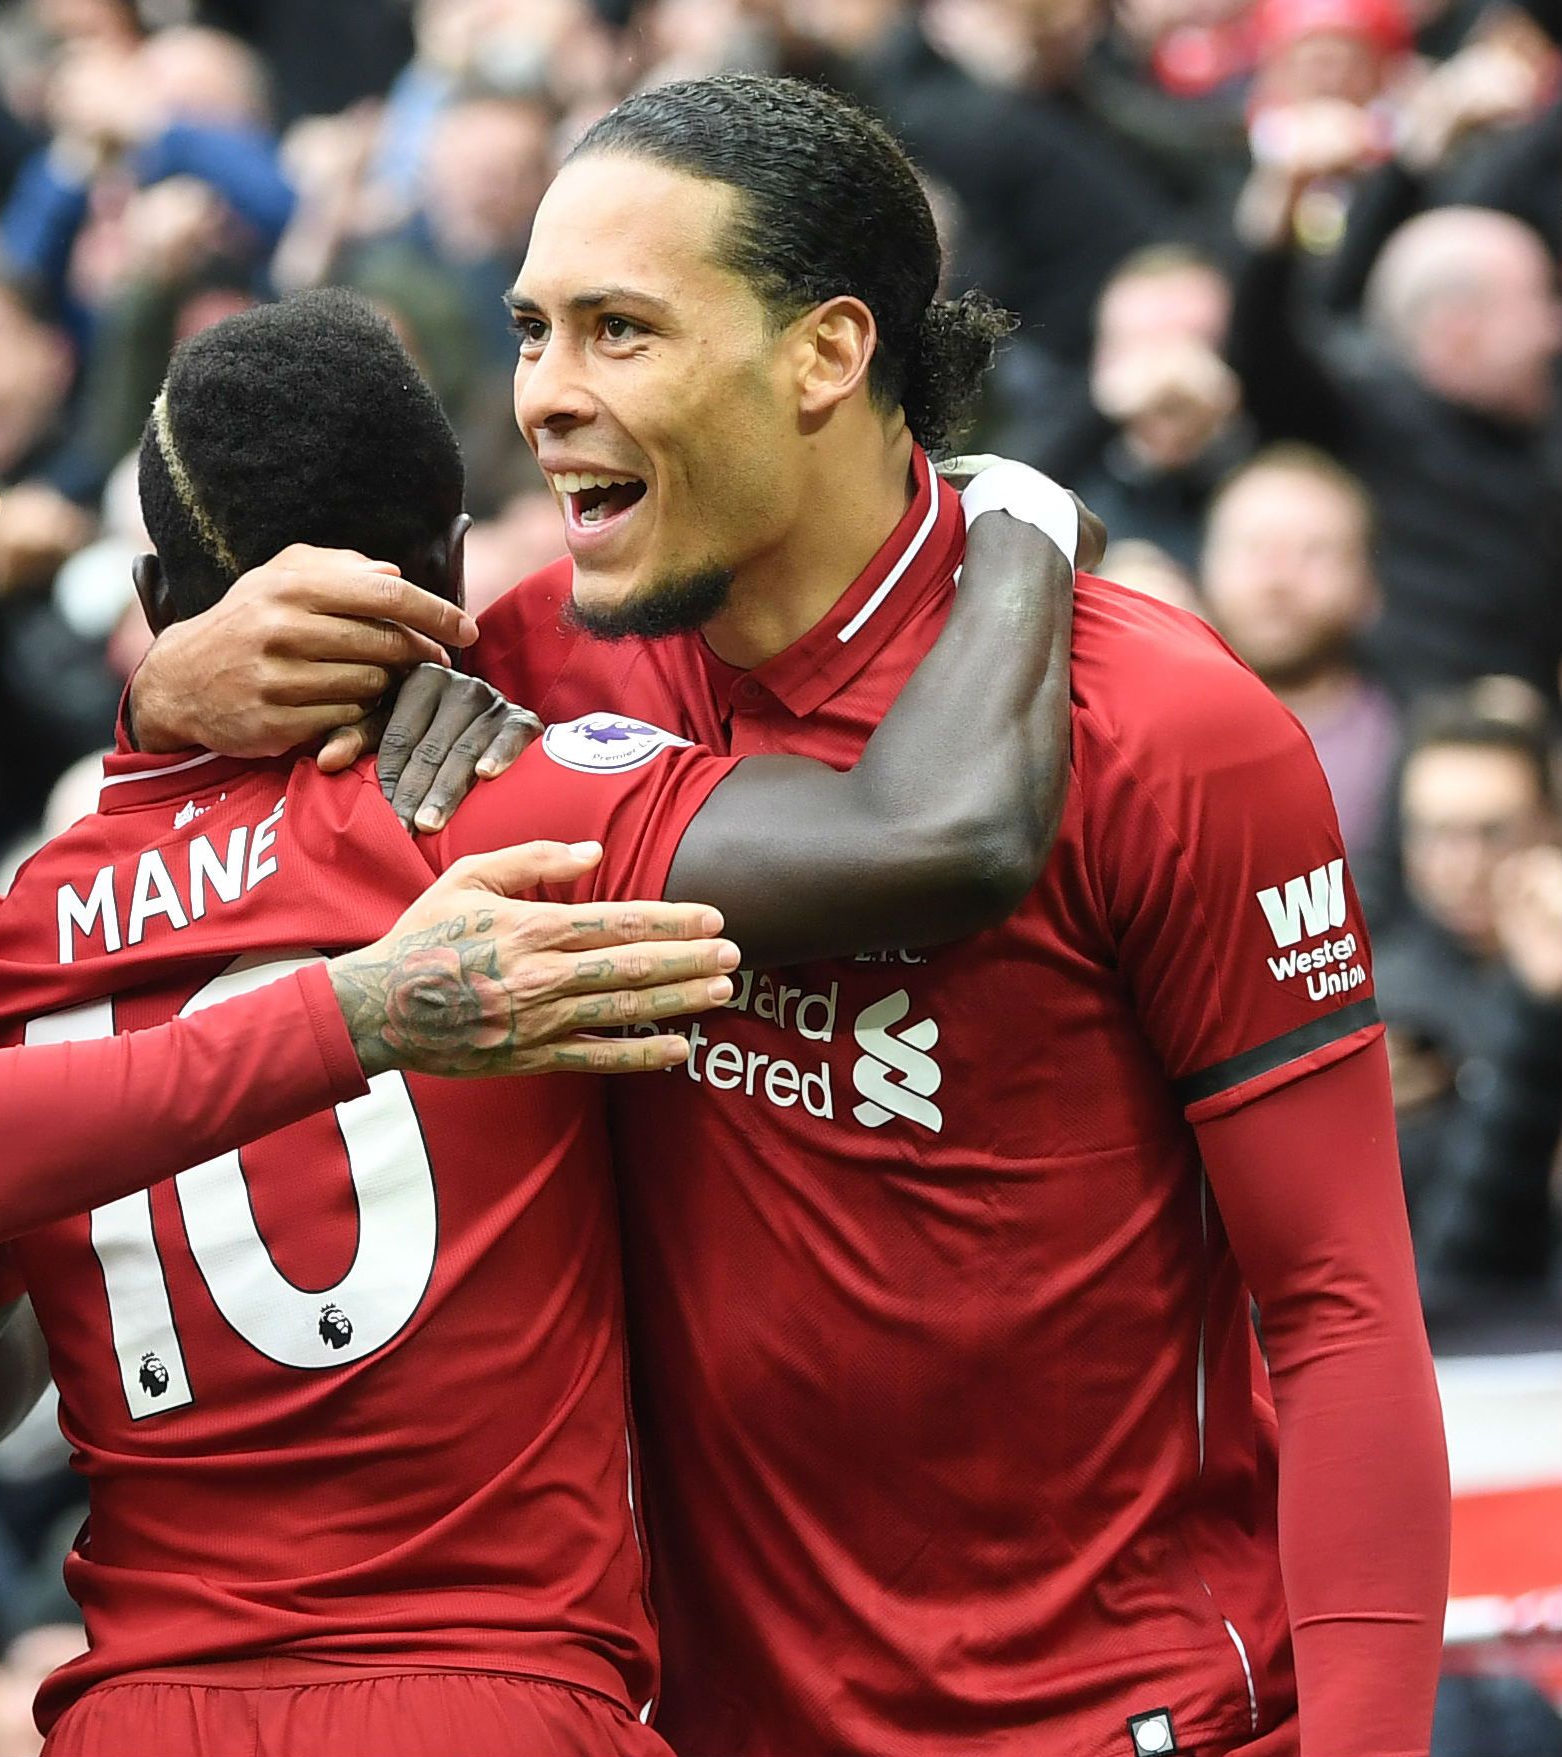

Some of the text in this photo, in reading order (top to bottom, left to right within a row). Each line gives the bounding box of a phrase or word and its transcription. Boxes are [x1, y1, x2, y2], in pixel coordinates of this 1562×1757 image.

[592, 748, 636, 760] Premier
[57, 796, 287, 957] MANÉ
[1266, 932, 1357, 981] Westen
[1306, 962, 1366, 1001] Union
[23, 948, 438, 1422] 10
